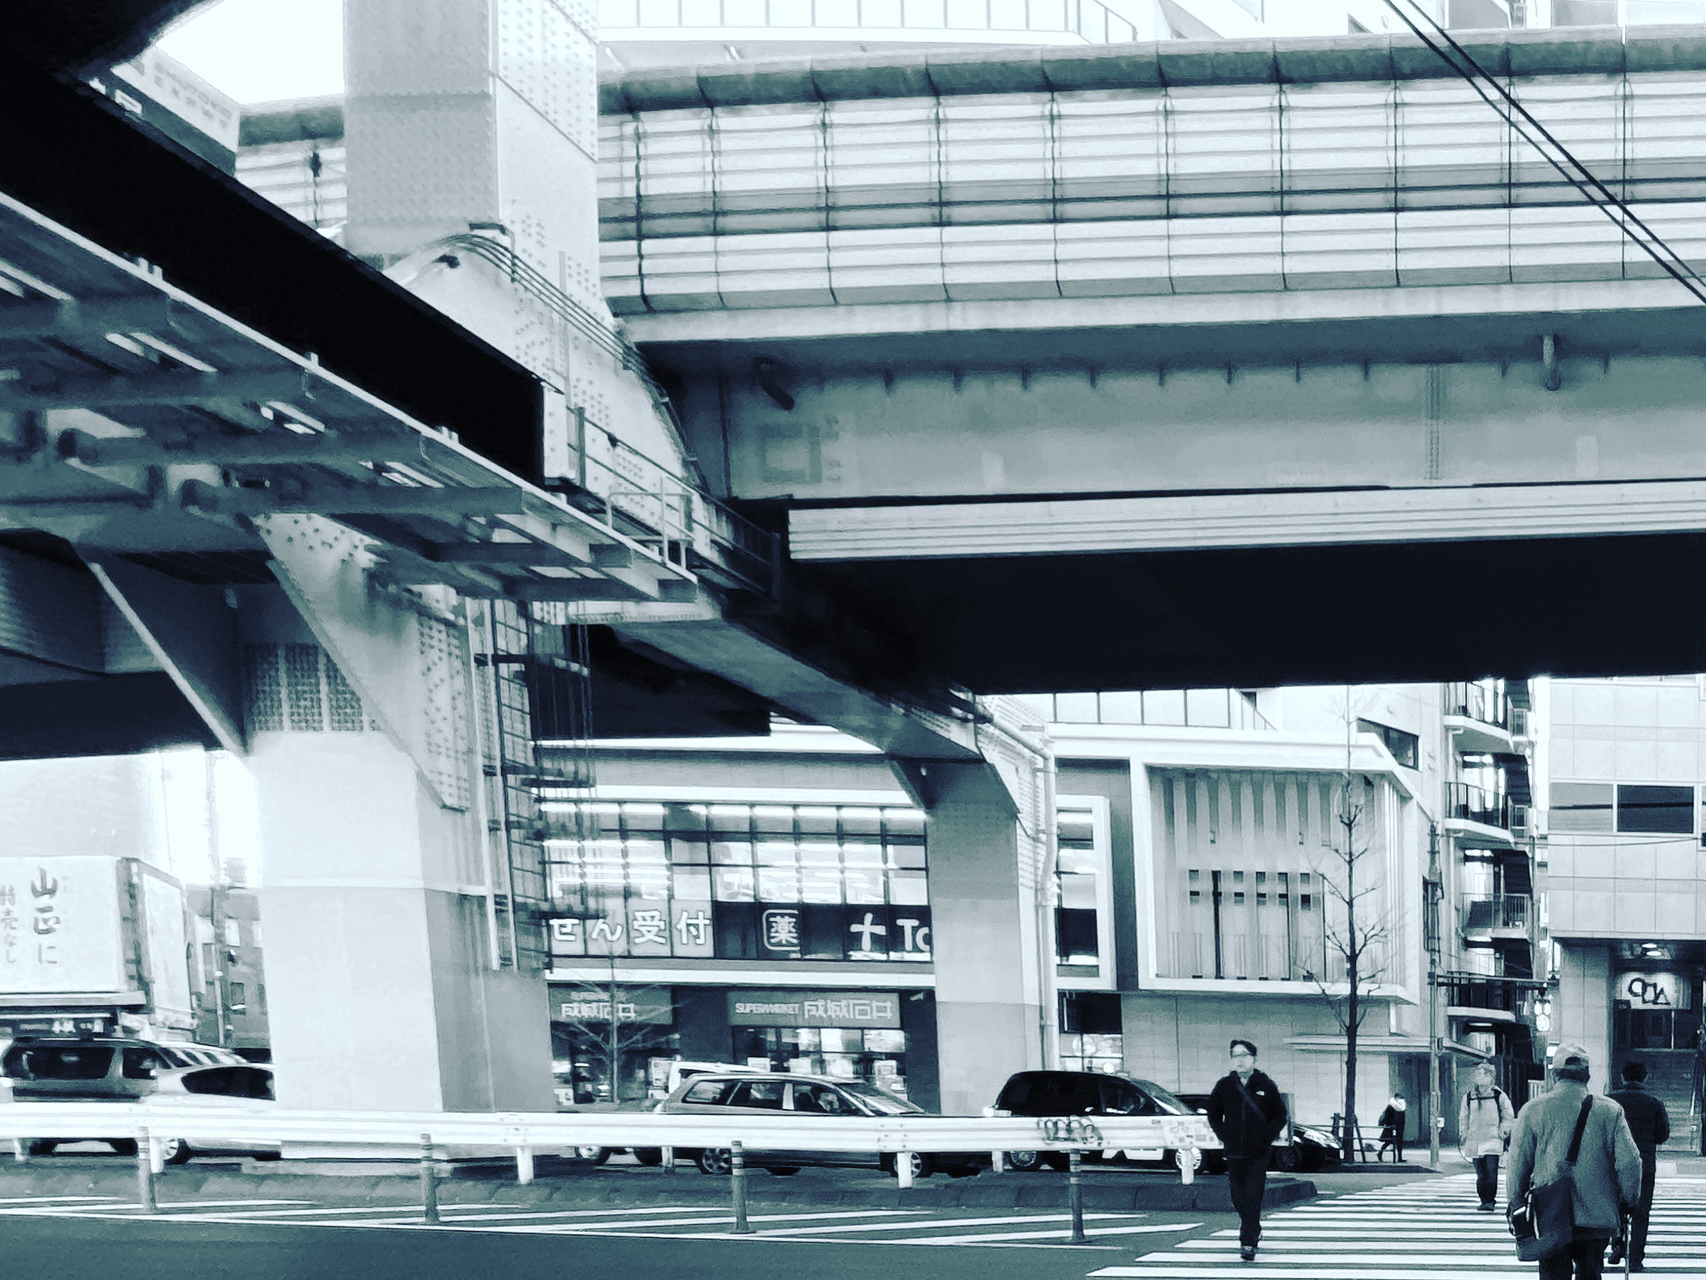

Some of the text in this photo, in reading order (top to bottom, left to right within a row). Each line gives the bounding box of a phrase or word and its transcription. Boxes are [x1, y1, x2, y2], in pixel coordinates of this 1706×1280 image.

[768, 914, 800, 946] 薬
[803, 998, 893, 1020] 成城石井
